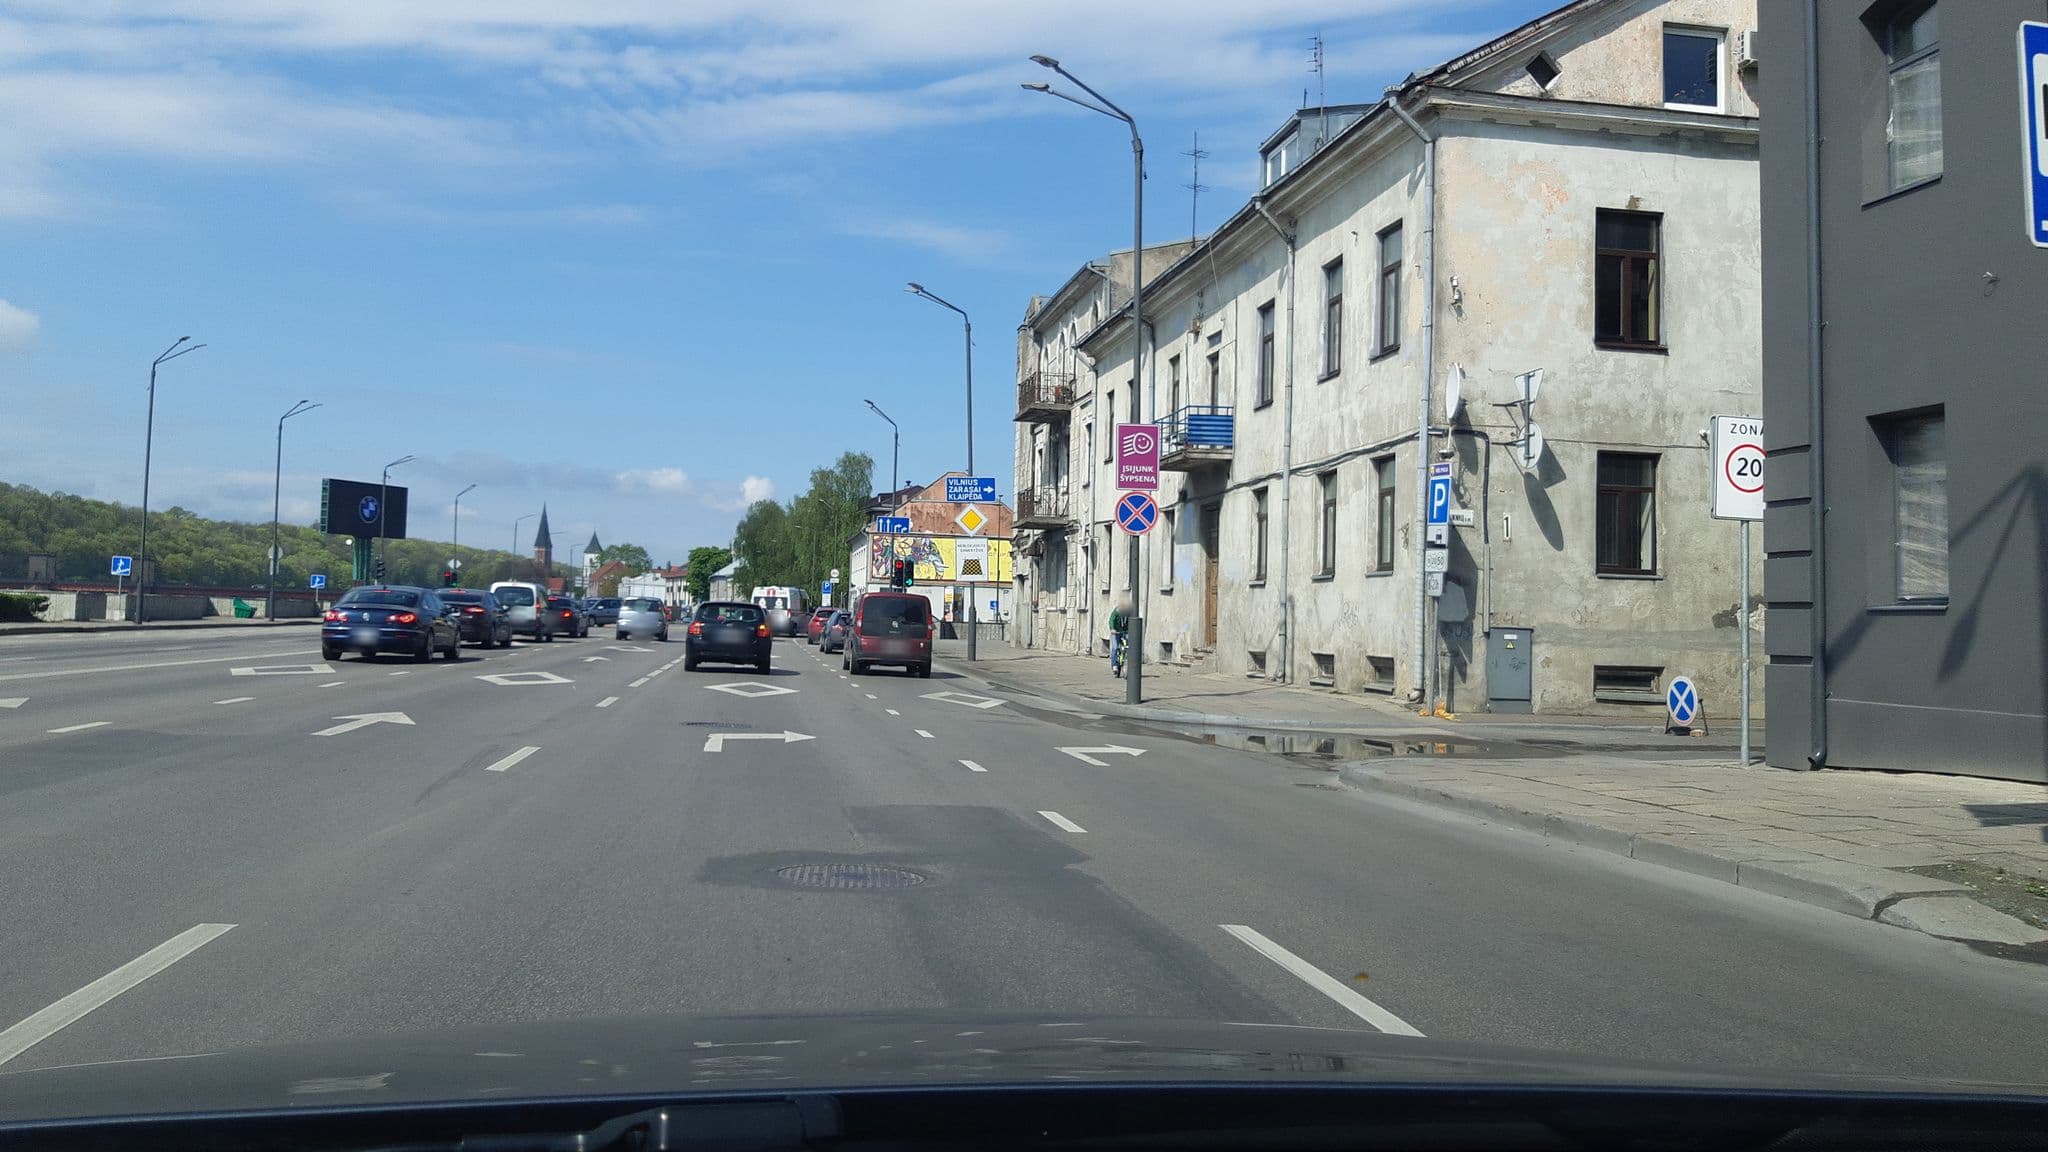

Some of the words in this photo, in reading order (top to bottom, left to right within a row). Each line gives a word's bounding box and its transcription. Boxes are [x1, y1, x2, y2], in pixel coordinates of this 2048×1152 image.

[1122, 465, 1154, 473] ĮSIJUNK
[1736, 457, 1762, 477] 20
[1120, 474, 1156, 484] ŠYPSENĄ
[948, 492, 983, 500] KLAIPĖDA
[1433, 483, 1446, 519] P
